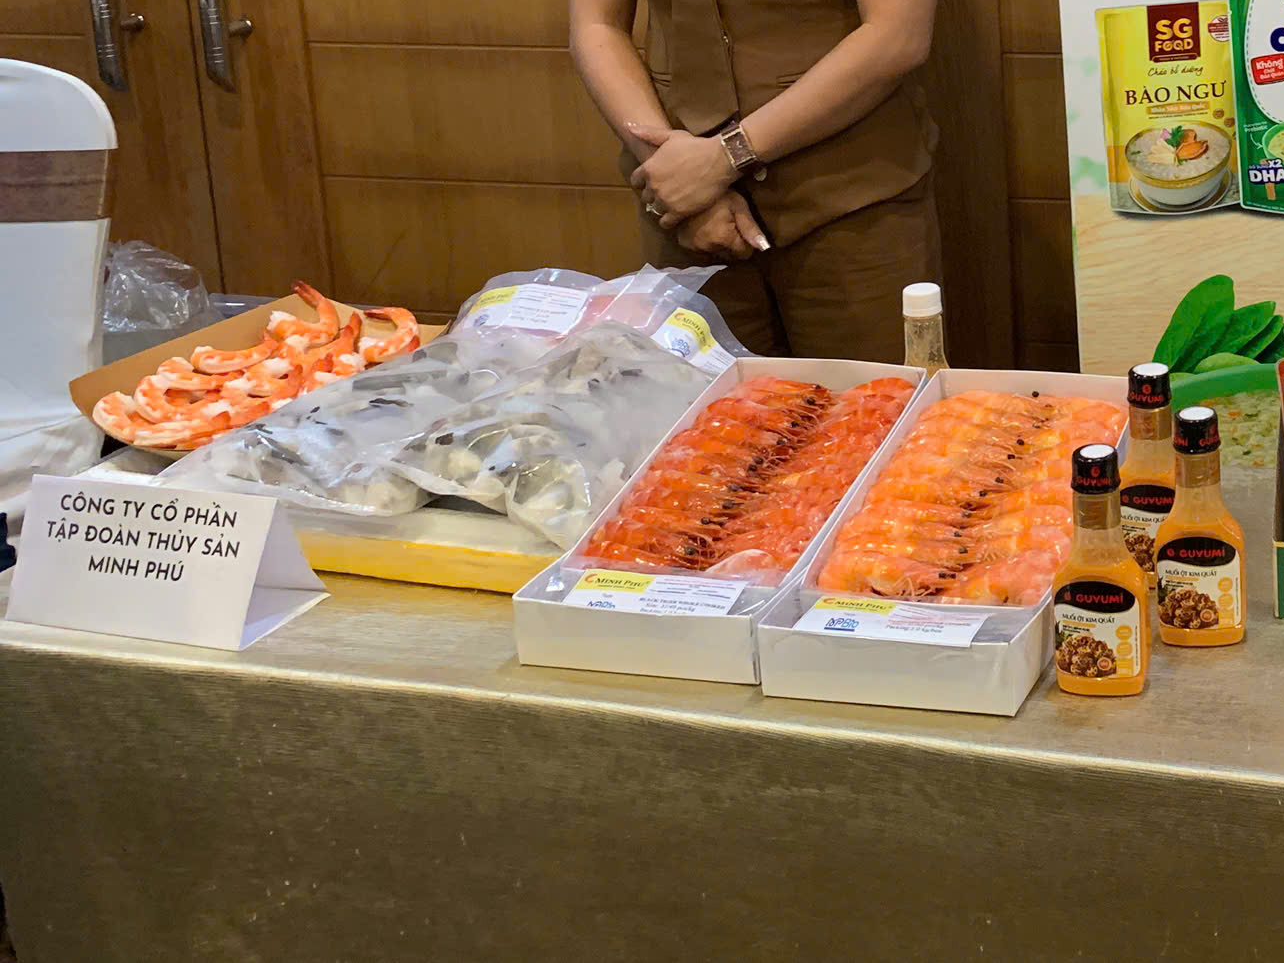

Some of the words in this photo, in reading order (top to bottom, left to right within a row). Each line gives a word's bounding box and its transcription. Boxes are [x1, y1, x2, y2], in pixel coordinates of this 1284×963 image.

[1155, 18, 1193, 40] SG
[1154, 39, 1193, 52] FOOD
[1256, 58, 1284, 70] Không
[1124, 86, 1171, 105] BÀO
[1176, 80, 1227, 101] NGƯ
[1268, 159, 1283, 168] X2
[60, 492, 115, 515] CÔNG
[123, 500, 145, 519] TY
[151, 497, 179, 522] CỔ
[184, 501, 237, 528] PHẦN
[48, 518, 79, 542] TẬP
[85, 524, 141, 547] ĐOÀN
[148, 530, 197, 554] THỦY
[202, 534, 240, 558] SẢN
[88, 556, 139, 576] MINH
[145, 560, 184, 582] PHÚ
[595, 578, 622, 586] MINH
